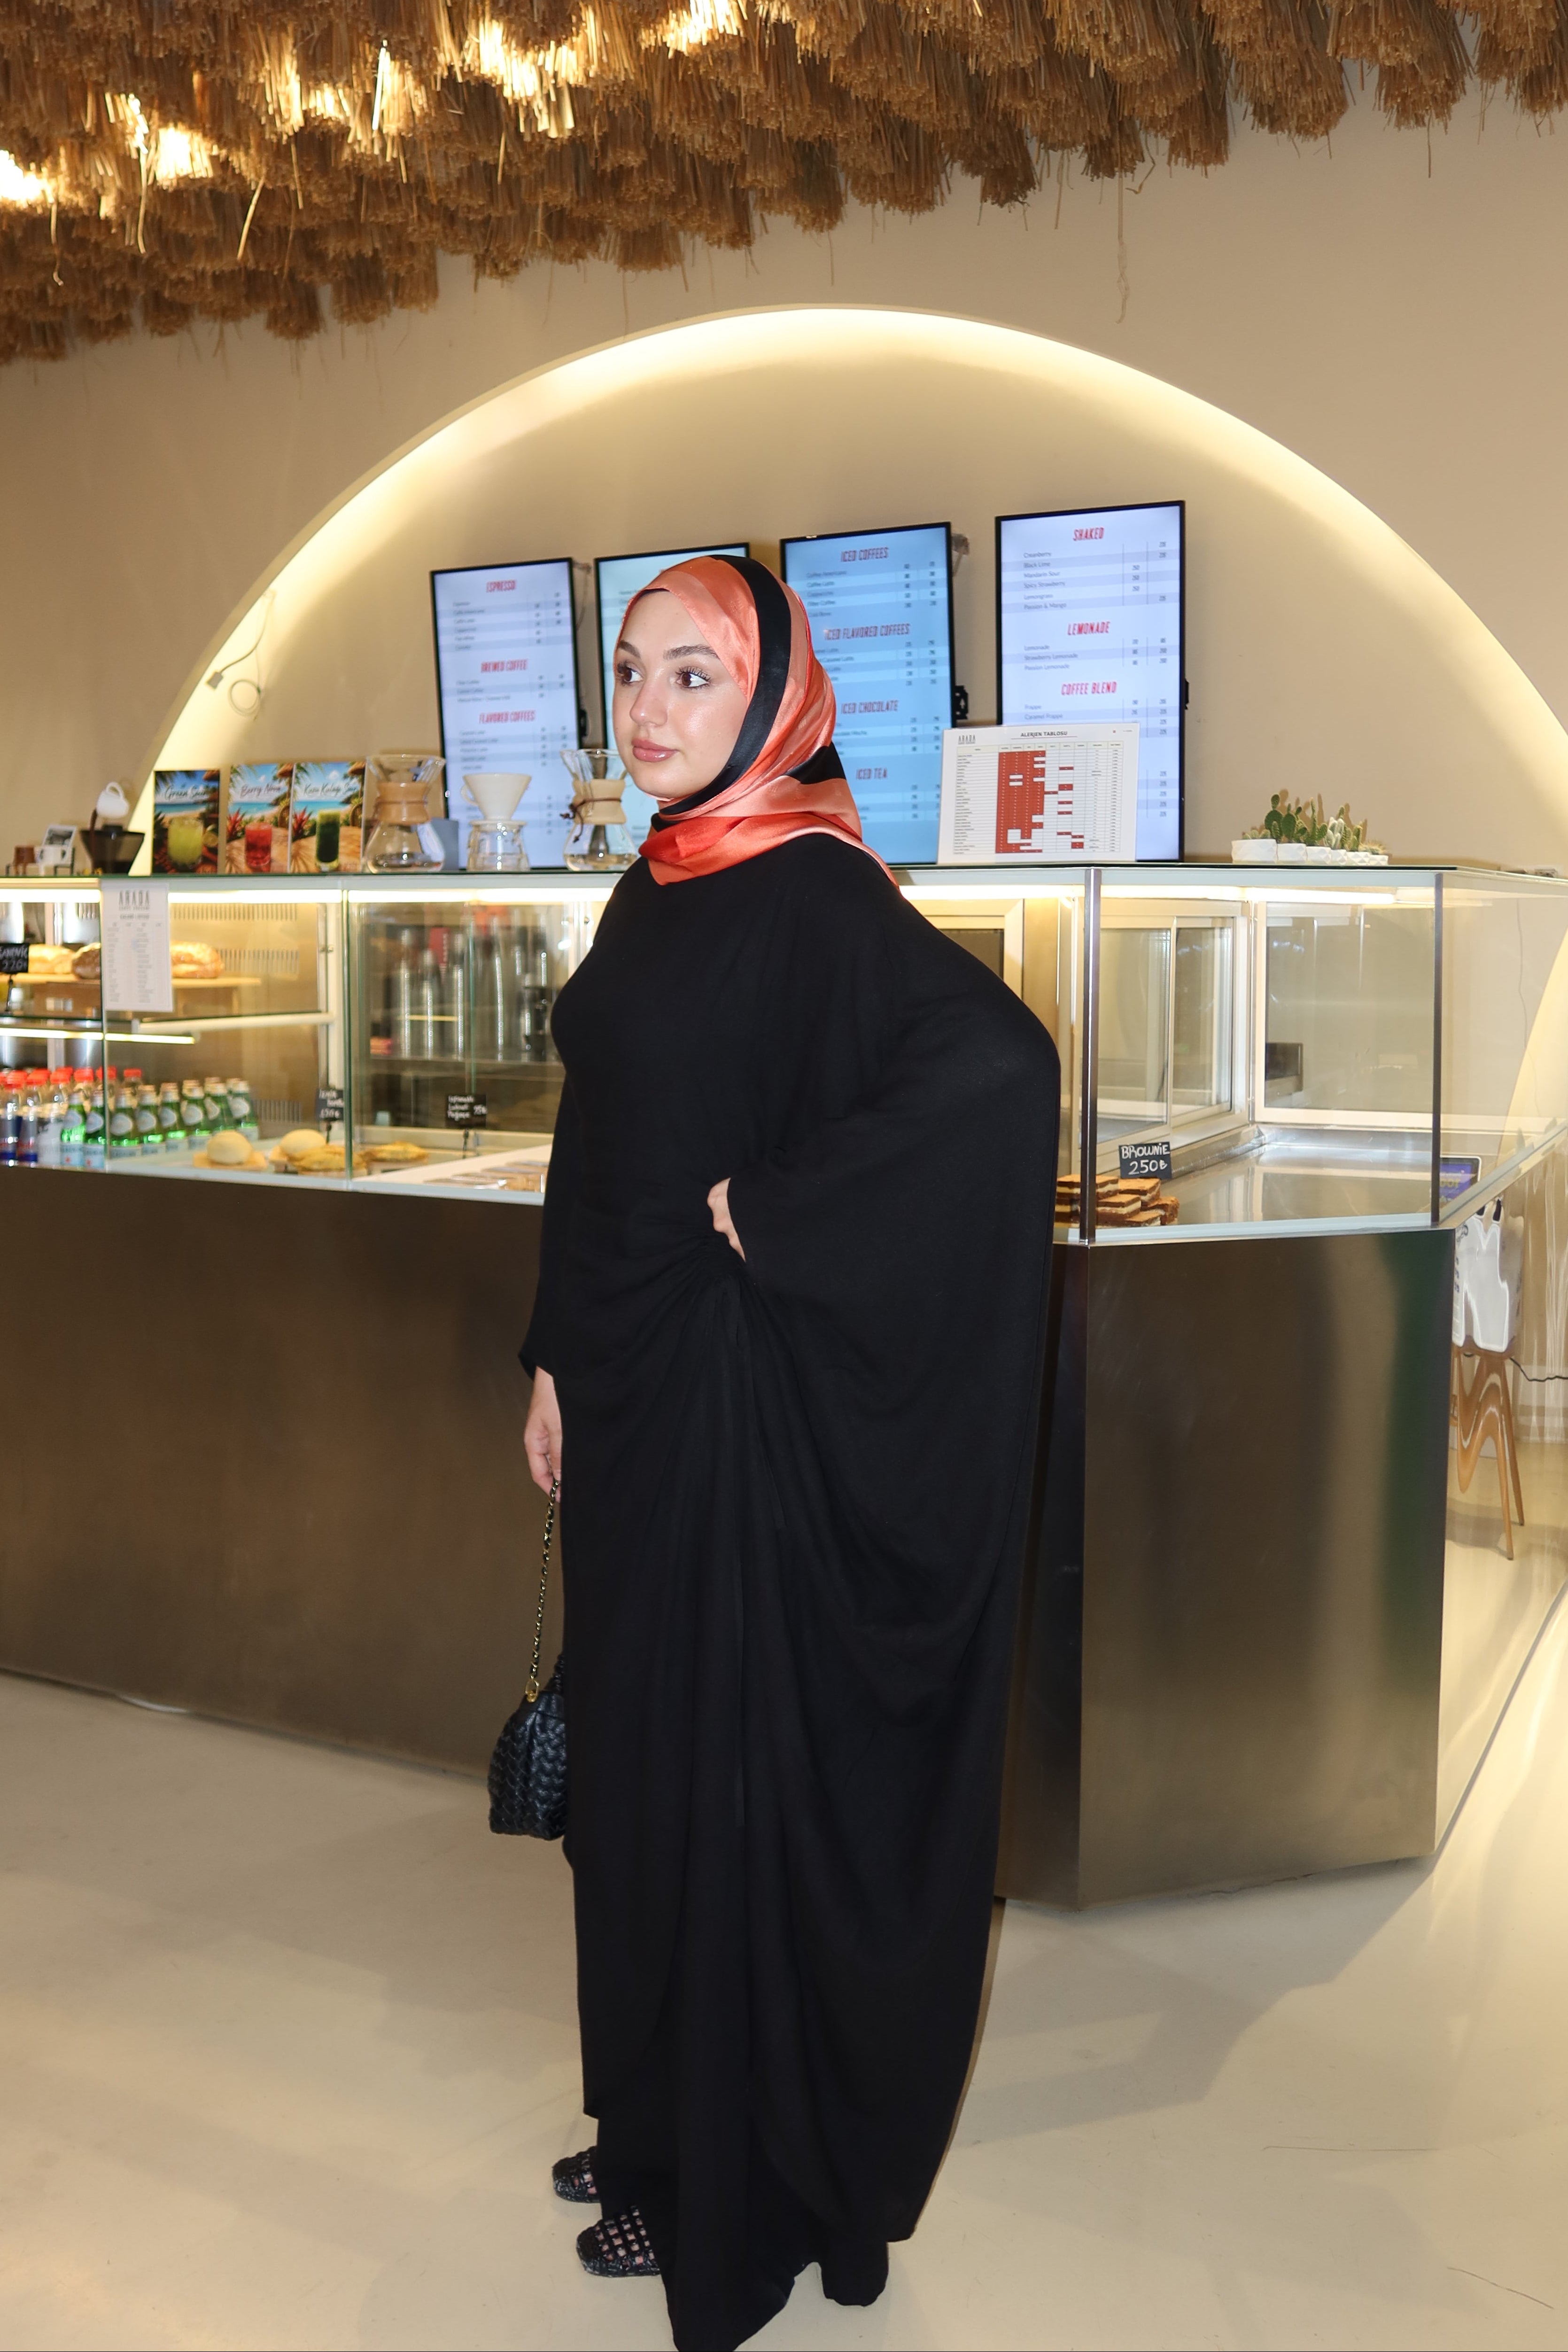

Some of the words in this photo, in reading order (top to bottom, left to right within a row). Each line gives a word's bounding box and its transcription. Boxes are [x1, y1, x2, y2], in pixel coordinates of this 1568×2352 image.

[1073, 527, 1104, 541] SHAKED
[841, 551, 856, 562] ICED
[858, 547, 888, 561] COFFEES
[487, 580, 516, 593] ESPRESSO
[842, 626, 878, 639] FLAVORED
[880, 623, 910, 637] COFFEES
[1068, 622, 1110, 635] LEMONADE
[1062, 683, 1089, 695] COFFEE
[1092, 681, 1117, 694] BLEND
[841, 703, 856, 714] ICED
[859, 700, 899, 713] CHOCOLATE
[510, 710, 536, 723] COFFEES
[856, 768, 872, 780] ICED
[874, 768, 888, 779] TEA
